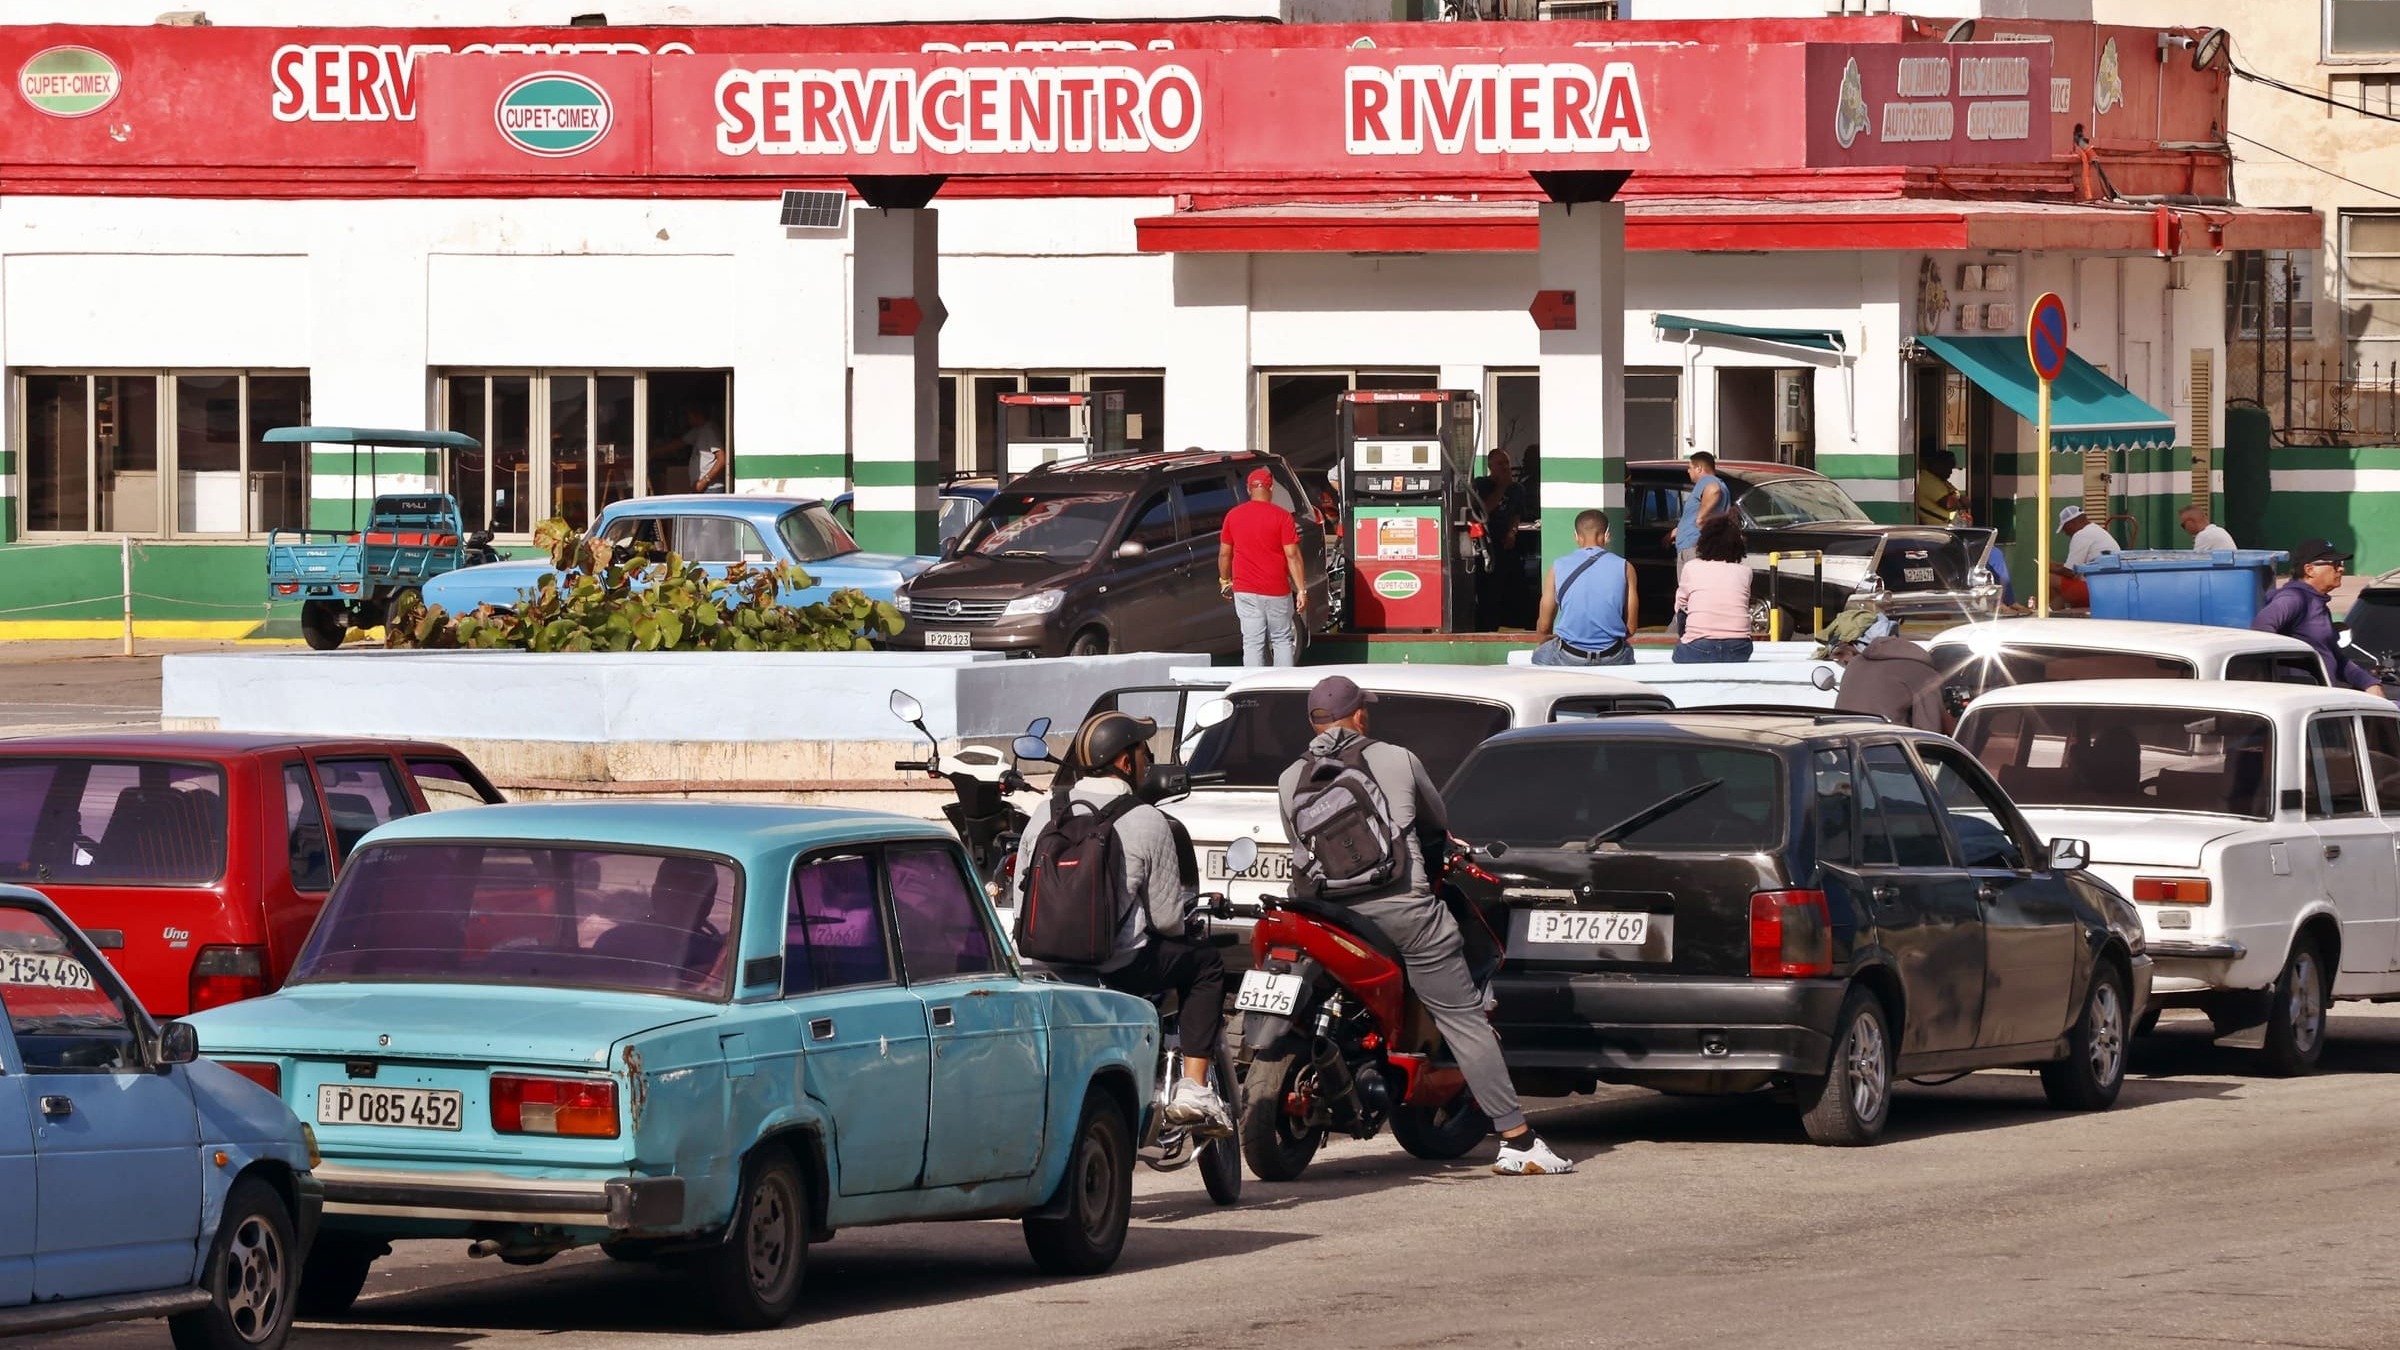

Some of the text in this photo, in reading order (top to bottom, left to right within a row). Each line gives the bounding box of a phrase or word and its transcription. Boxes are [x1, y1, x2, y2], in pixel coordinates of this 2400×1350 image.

[26, 75, 111, 95] CUPET-CIMEX
[1915, 62, 1949, 92] AMIGO
[1961, 62, 1977, 91] LAS
[1981, 62, 1993, 91] 24
[1995, 61, 2028, 91] HORAS
[506, 108, 599, 129] CUPET-CIMEX
[718, 71, 1199, 148] SERVICENTRO
[1349, 70, 1647, 148] RIVIERA
[1376, 581, 1418, 590] CUPET-CIMEX
[163, 927, 189, 940] Uno
[1266, 976, 1277, 990] U
[1239, 991, 1291, 1011] 51175
